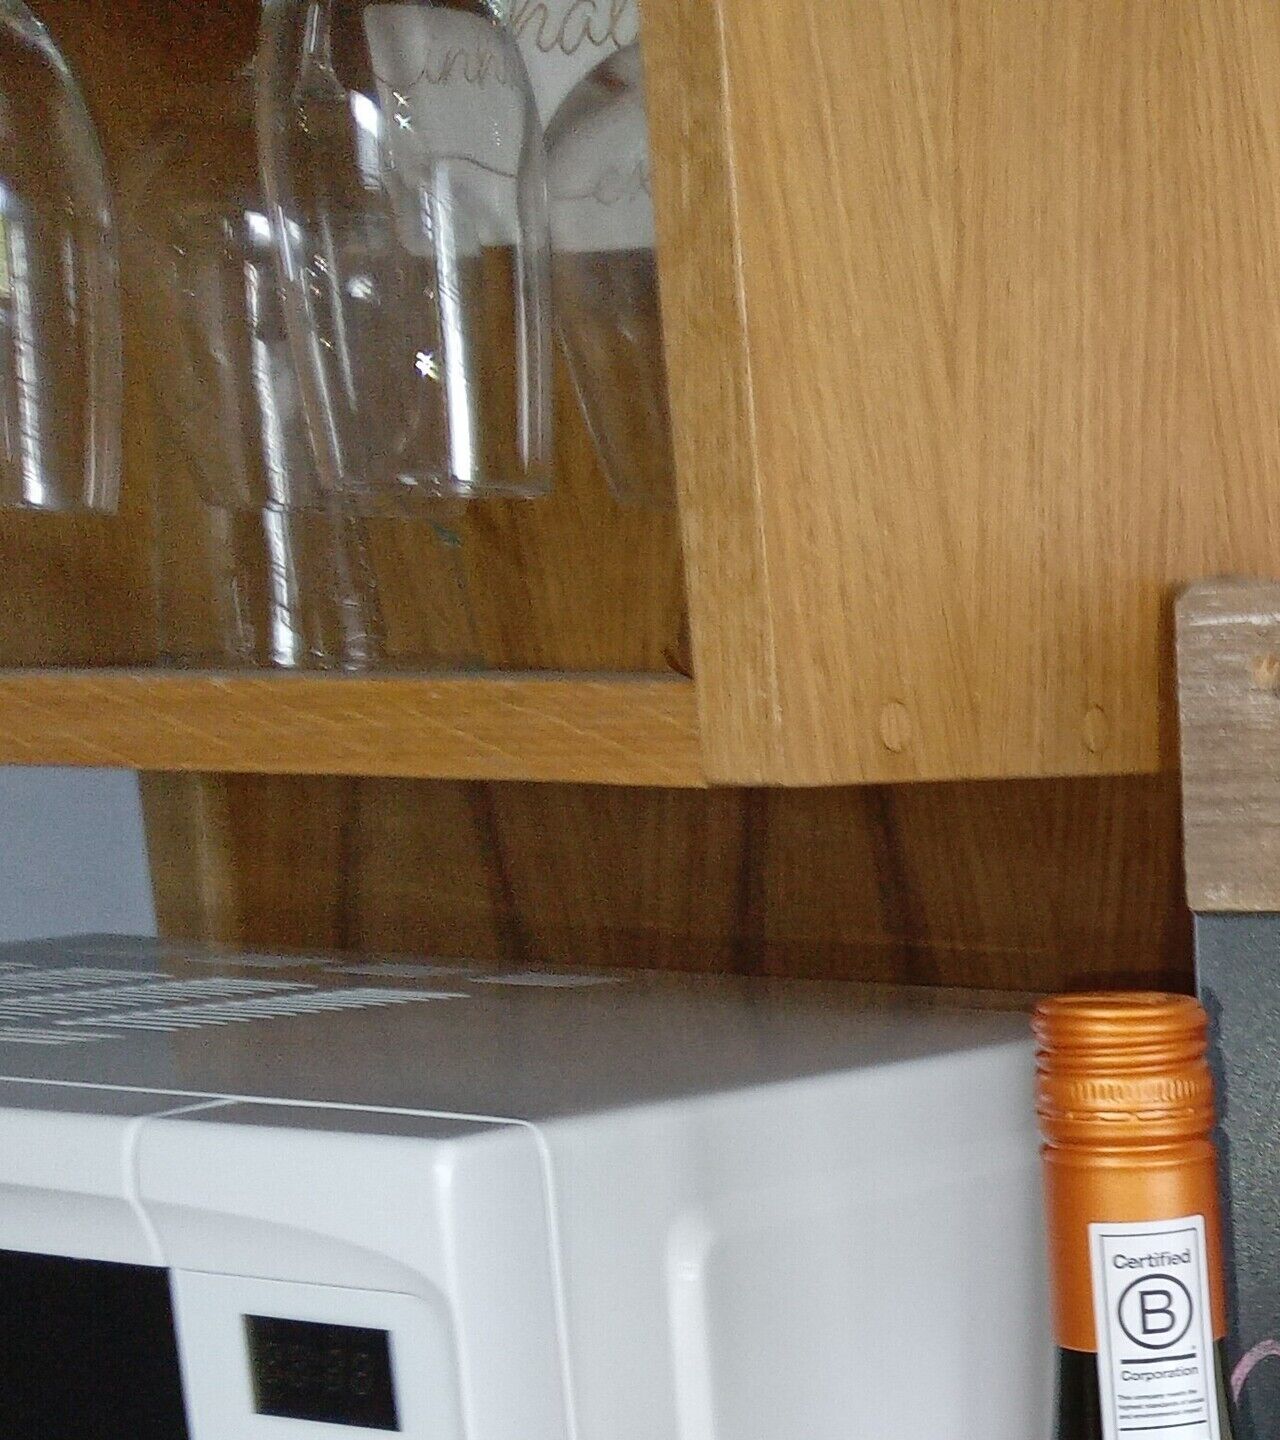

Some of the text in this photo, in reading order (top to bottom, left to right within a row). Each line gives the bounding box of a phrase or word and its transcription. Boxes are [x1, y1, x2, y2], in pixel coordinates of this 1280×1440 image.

[1113, 1248, 1191, 1269] Certified
[1139, 1289, 1176, 1335] B
[1121, 1366, 1199, 1382] Corporation
